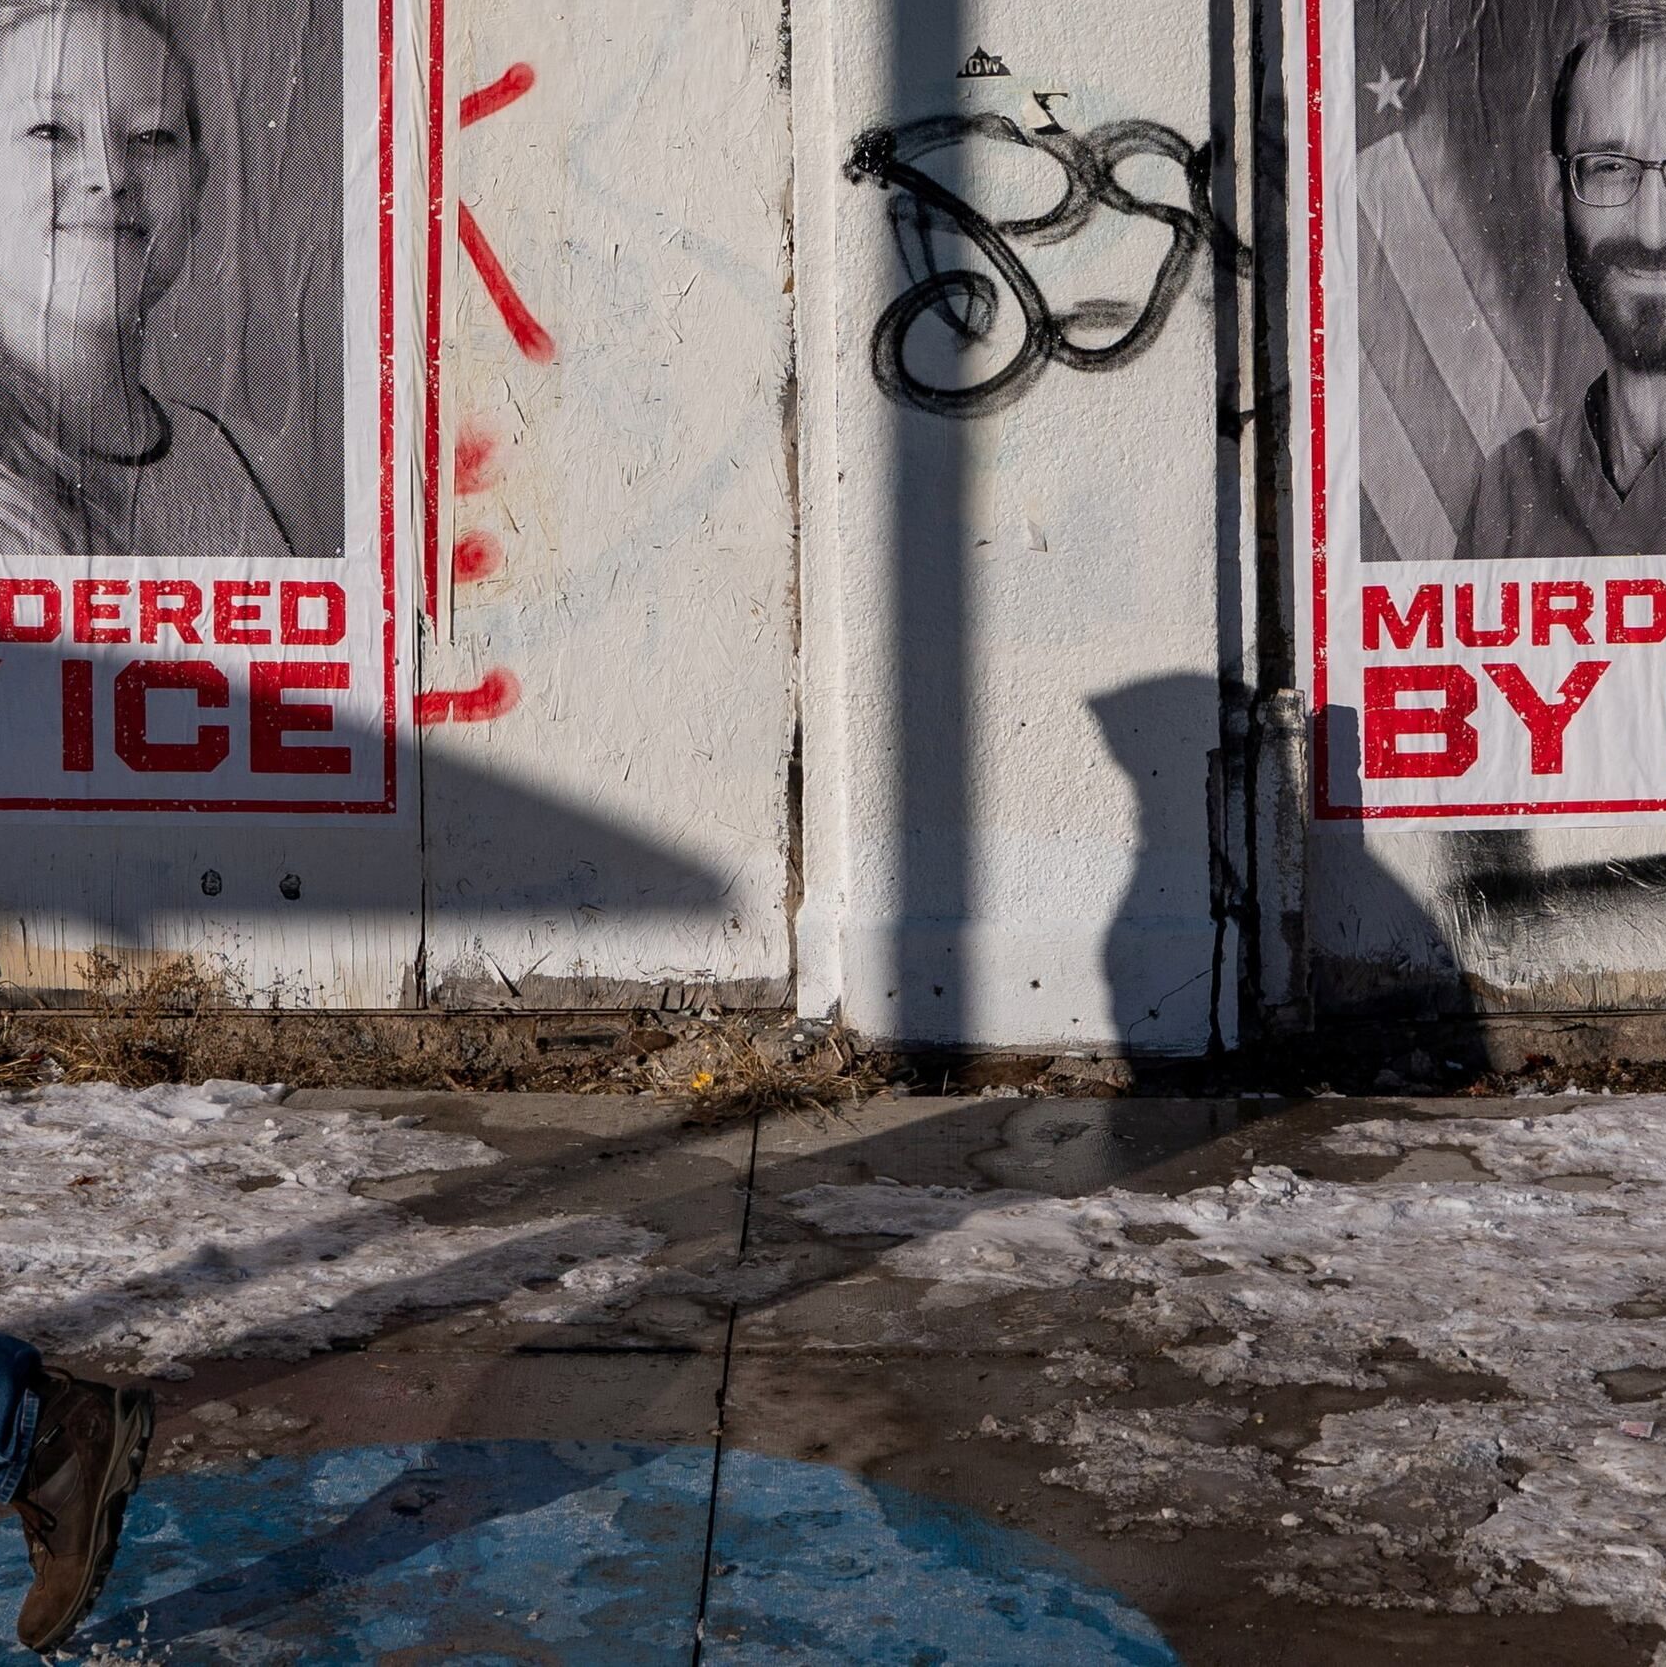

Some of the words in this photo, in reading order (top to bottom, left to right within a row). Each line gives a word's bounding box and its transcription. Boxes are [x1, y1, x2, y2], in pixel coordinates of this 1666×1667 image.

[961, 58, 1001, 75] OW
[61, 659, 351, 774] ICE
[1363, 660, 1612, 780] BY
